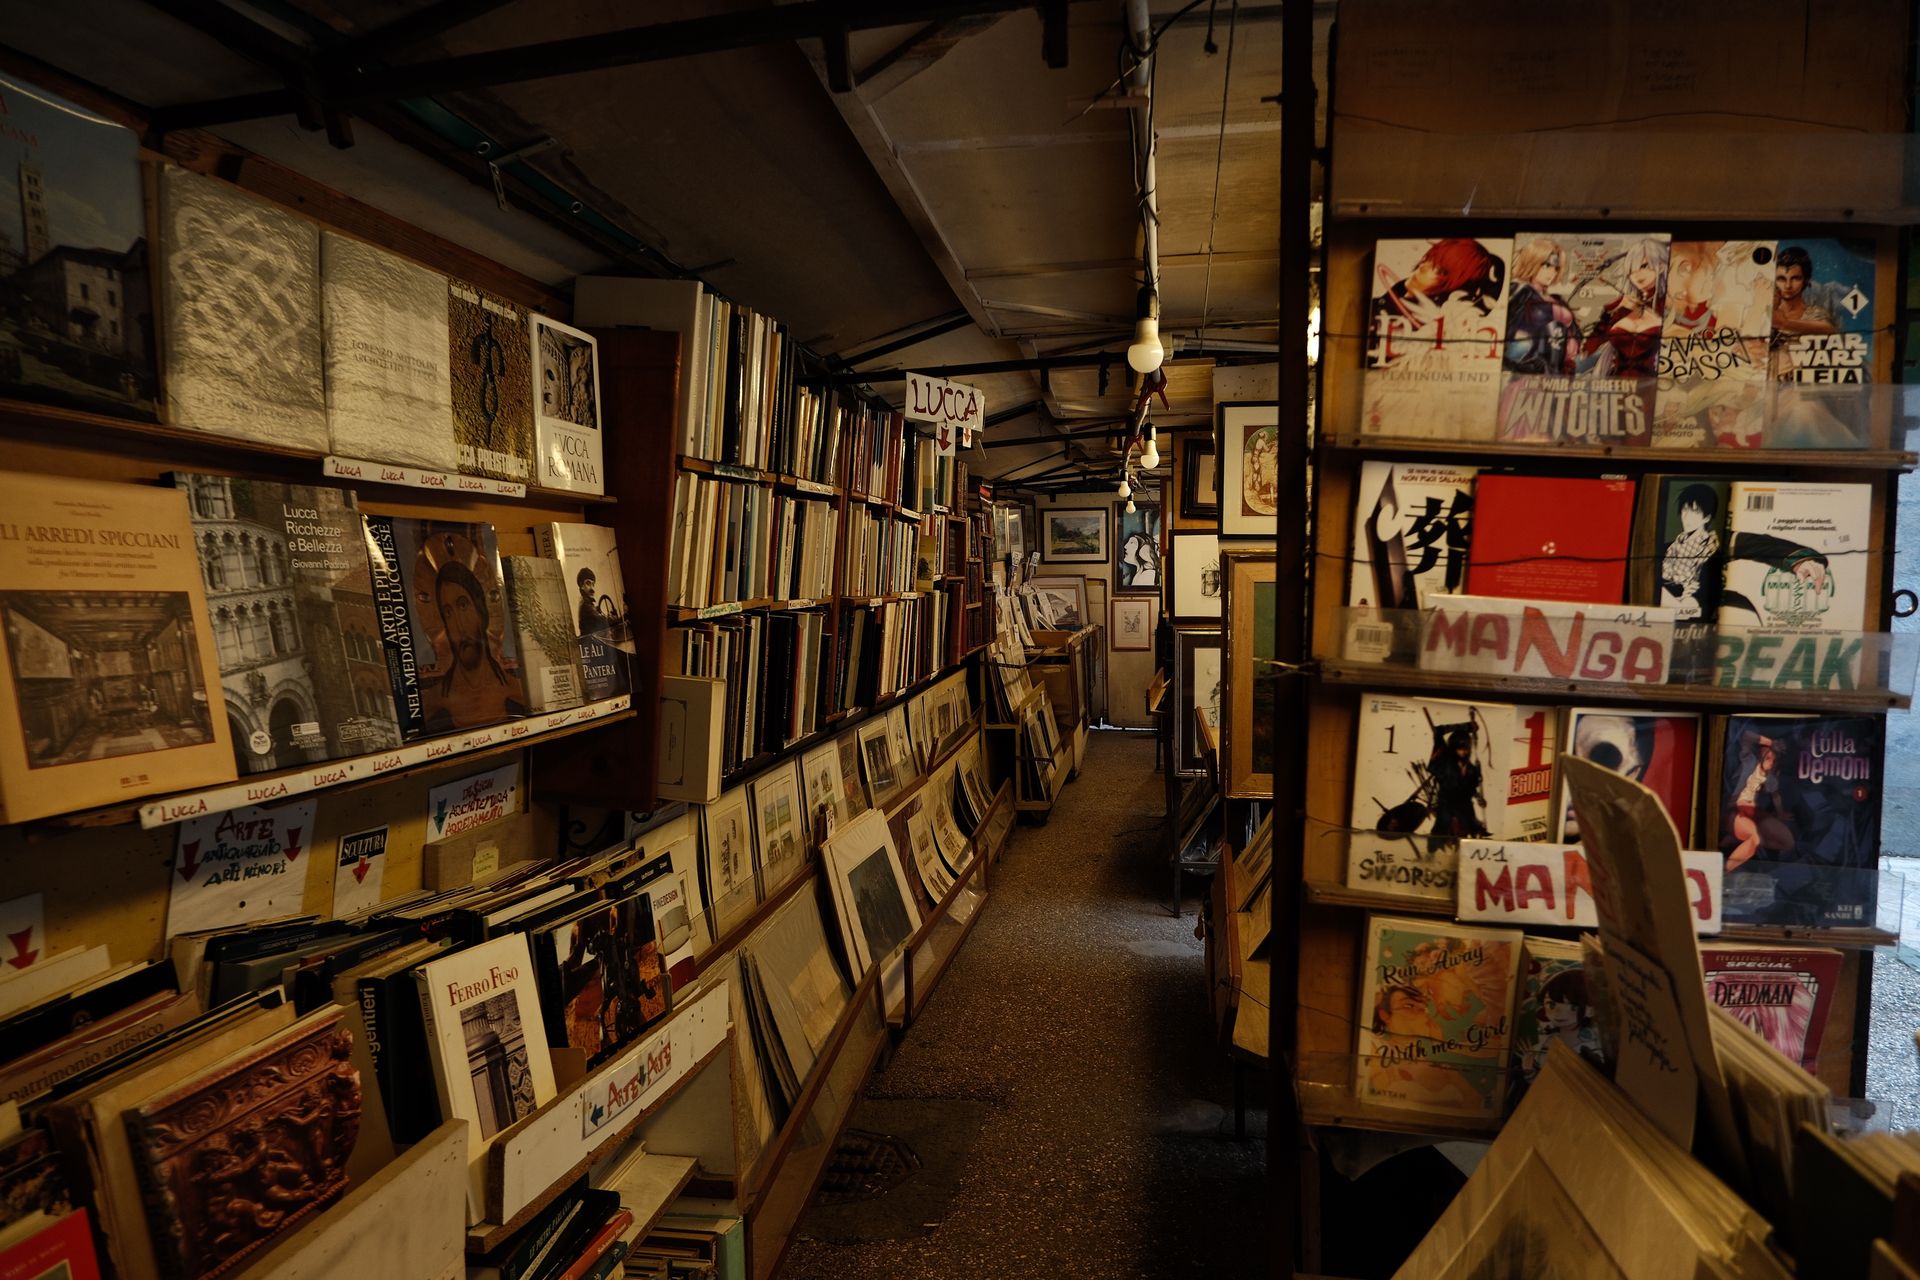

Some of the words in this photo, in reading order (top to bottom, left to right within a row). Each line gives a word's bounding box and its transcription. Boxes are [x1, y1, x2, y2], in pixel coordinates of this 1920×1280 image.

[1850, 294, 1858, 310] 1
[1789, 333, 1868, 350] STAR
[1790, 350, 1867, 367] WARS
[911, 378, 979, 422] LUCCA
[1543, 378, 1570, 391] WAR
[1591, 379, 1638, 393] GREEDY
[1504, 391, 1646, 441] WITCHES
[334, 463, 362, 478] LUCCA
[381, 468, 405, 482] LUCCA
[421, 474, 445, 487] LUCCA
[548, 455, 597, 484] RMANA
[283, 504, 318, 520] Lucca
[24, 527, 95, 545] ARREDI
[100, 530, 180, 549] SPICCIANI
[285, 521, 341, 537] Ricchezze
[288, 541, 297, 551] e
[298, 539, 343, 553] Bellezza
[367, 523, 391, 589] PITRA
[292, 558, 324, 569] Giovanni
[379, 523, 405, 602] LUCCHESE
[378, 603, 399, 645] ARTE
[393, 606, 420, 687] MEDIOEVO
[1426, 606, 1663, 683] MANGA
[582, 664, 617, 679] PANTERA
[408, 689, 422, 719] NEL
[1383, 726, 1398, 754] 1
[1525, 712, 1545, 768] 1
[1811, 730, 1856, 758] Culla
[161, 799, 208, 822] LUCCA
[247, 783, 288, 801] LUCCA
[313, 769, 347, 787] LUCCA
[373, 756, 402, 772] LUCCA
[426, 743, 453, 758] LUCCA
[472, 734, 492, 747] LUCCA
[1798, 753, 1871, 784] Demoni
[215, 810, 274, 842] ARTE
[341, 834, 386, 860] SCULTURA
[1374, 850, 1394, 863] THE
[1359, 858, 1457, 889] SWORDS
[1377, 964, 1419, 985] Run
[1426, 946, 1485, 975] Away
[1726, 961, 1792, 969] SPECIAL
[447, 980, 490, 1007] FERRO
[489, 967, 519, 990] FUSO
[1714, 981, 1797, 1006] DEADMAN
[104, 1024, 164, 1057] artistico
[360, 987, 381, 1072] gentieri
[1377, 1040, 1426, 1068] With
[1467, 1016, 1507, 1052] Girl
[607, 1073, 640, 1119] ARTE
[648, 1041, 672, 1086] ARTE
